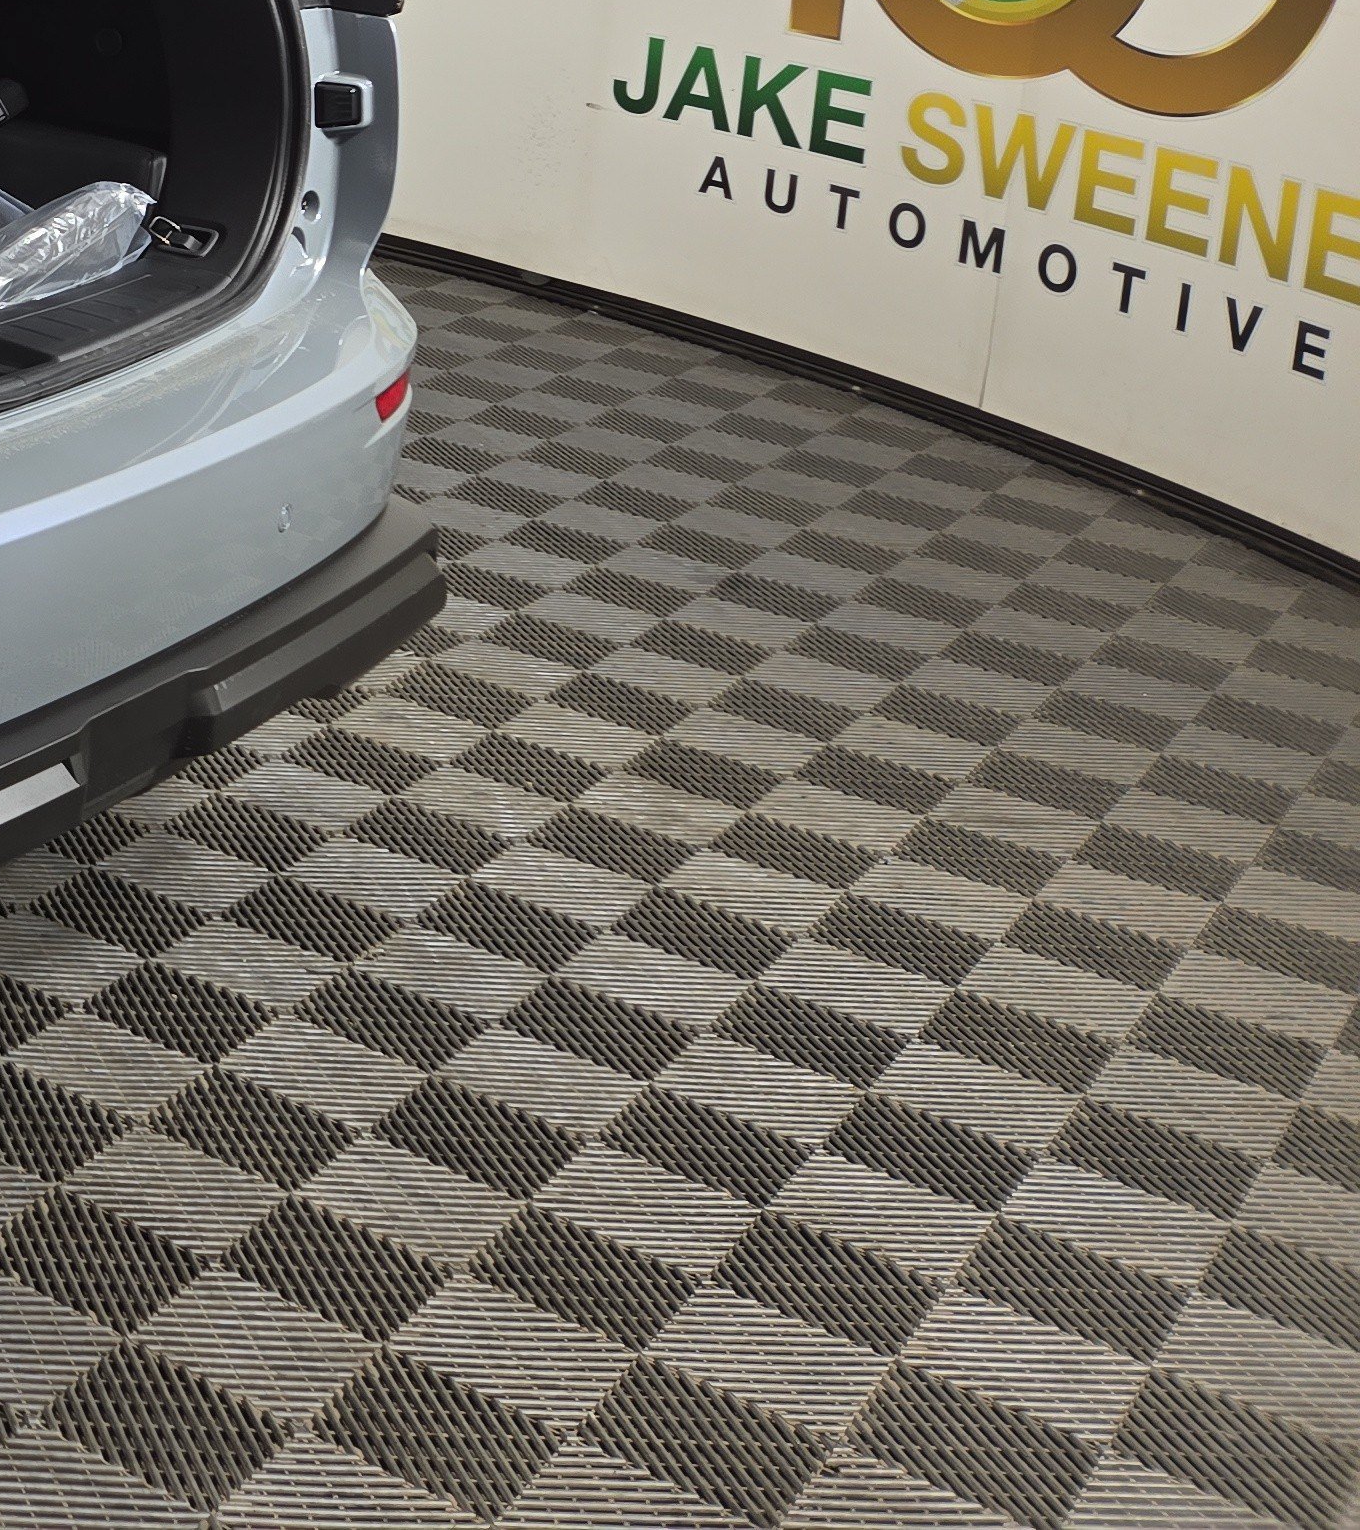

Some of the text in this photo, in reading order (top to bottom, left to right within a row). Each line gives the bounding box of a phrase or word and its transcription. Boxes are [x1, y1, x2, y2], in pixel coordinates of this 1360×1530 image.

[611, 36, 1360, 307] JAKE SWEENE
[697, 155, 1332, 381] AUTOMOTIVE
